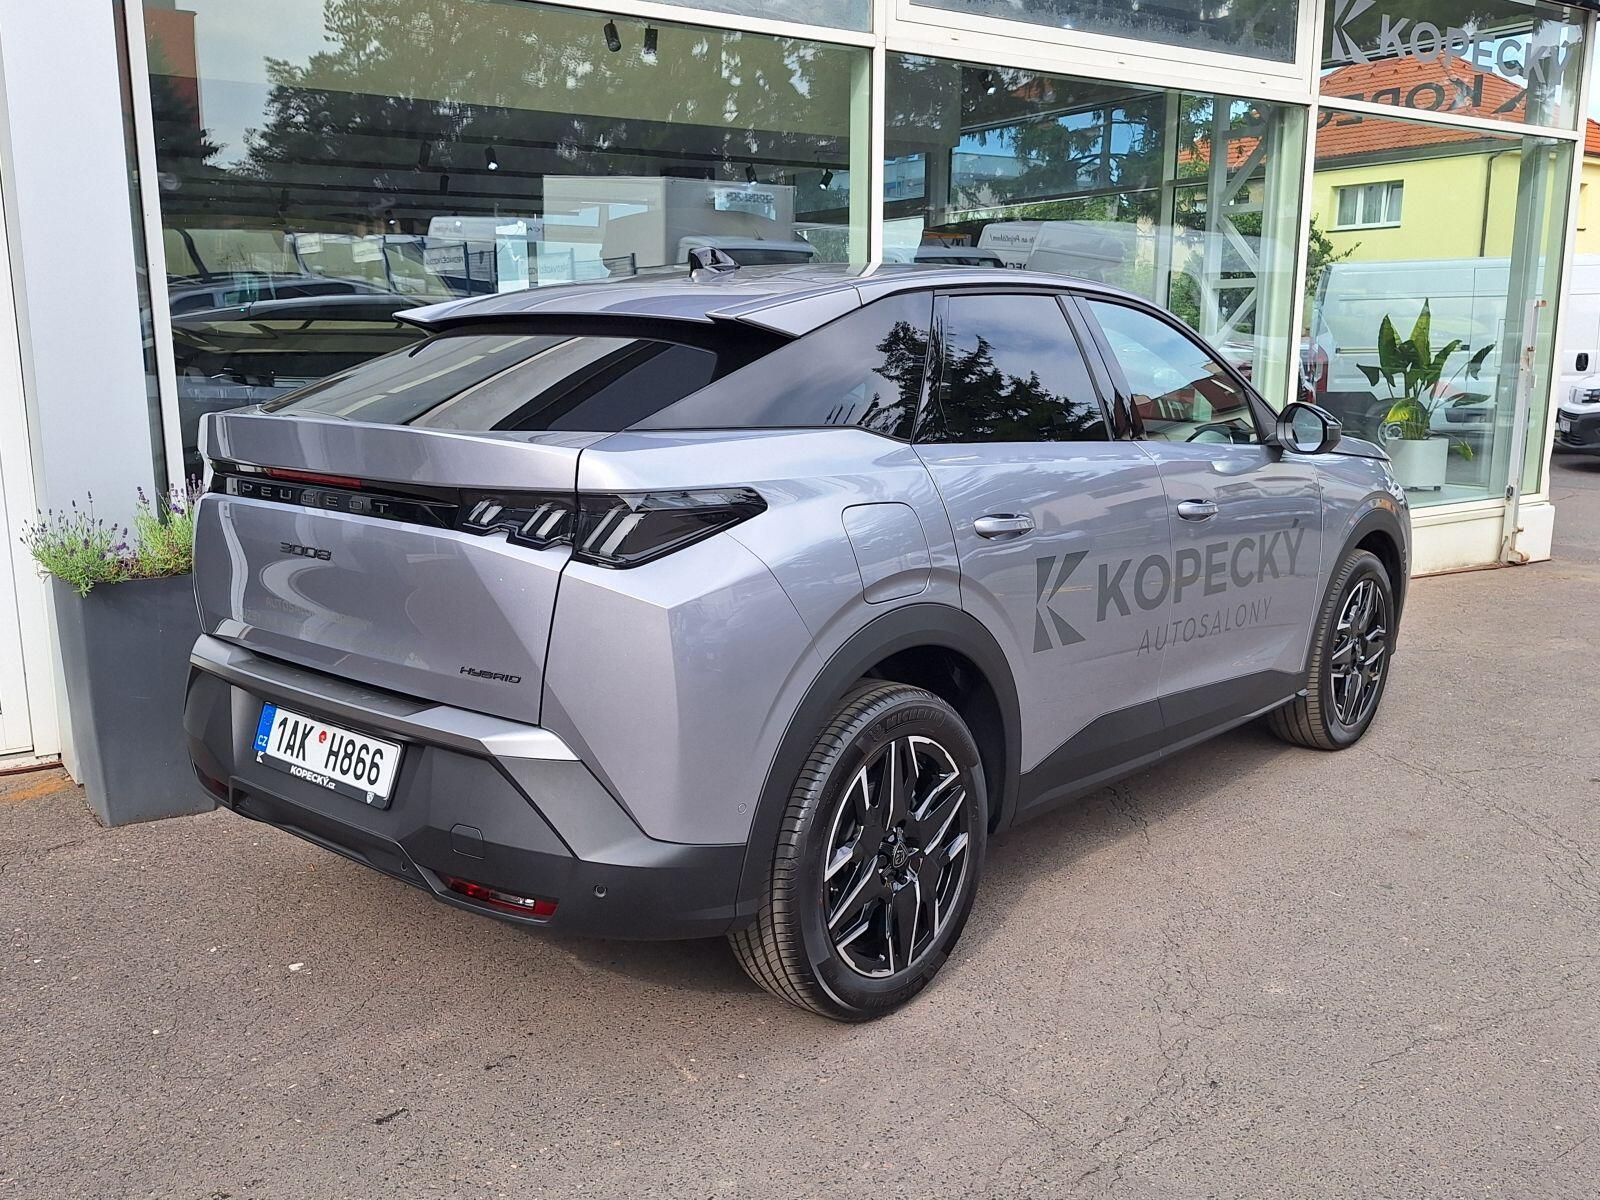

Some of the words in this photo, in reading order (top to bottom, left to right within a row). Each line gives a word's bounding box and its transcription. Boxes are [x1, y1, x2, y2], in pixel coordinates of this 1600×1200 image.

[1379, 14, 1574, 86] KOPECKÝ
[241, 483, 390, 514] PEUGEOT
[280, 541, 331, 561] 3008
[1096, 518, 1305, 622] KOPECKÝ
[1137, 597, 1272, 656] AUTOSALONY
[460, 665, 522, 684] HYBRID
[257, 734, 267, 747] CZ
[277, 717, 314, 762] 1AK
[324, 733, 384, 786] H866
